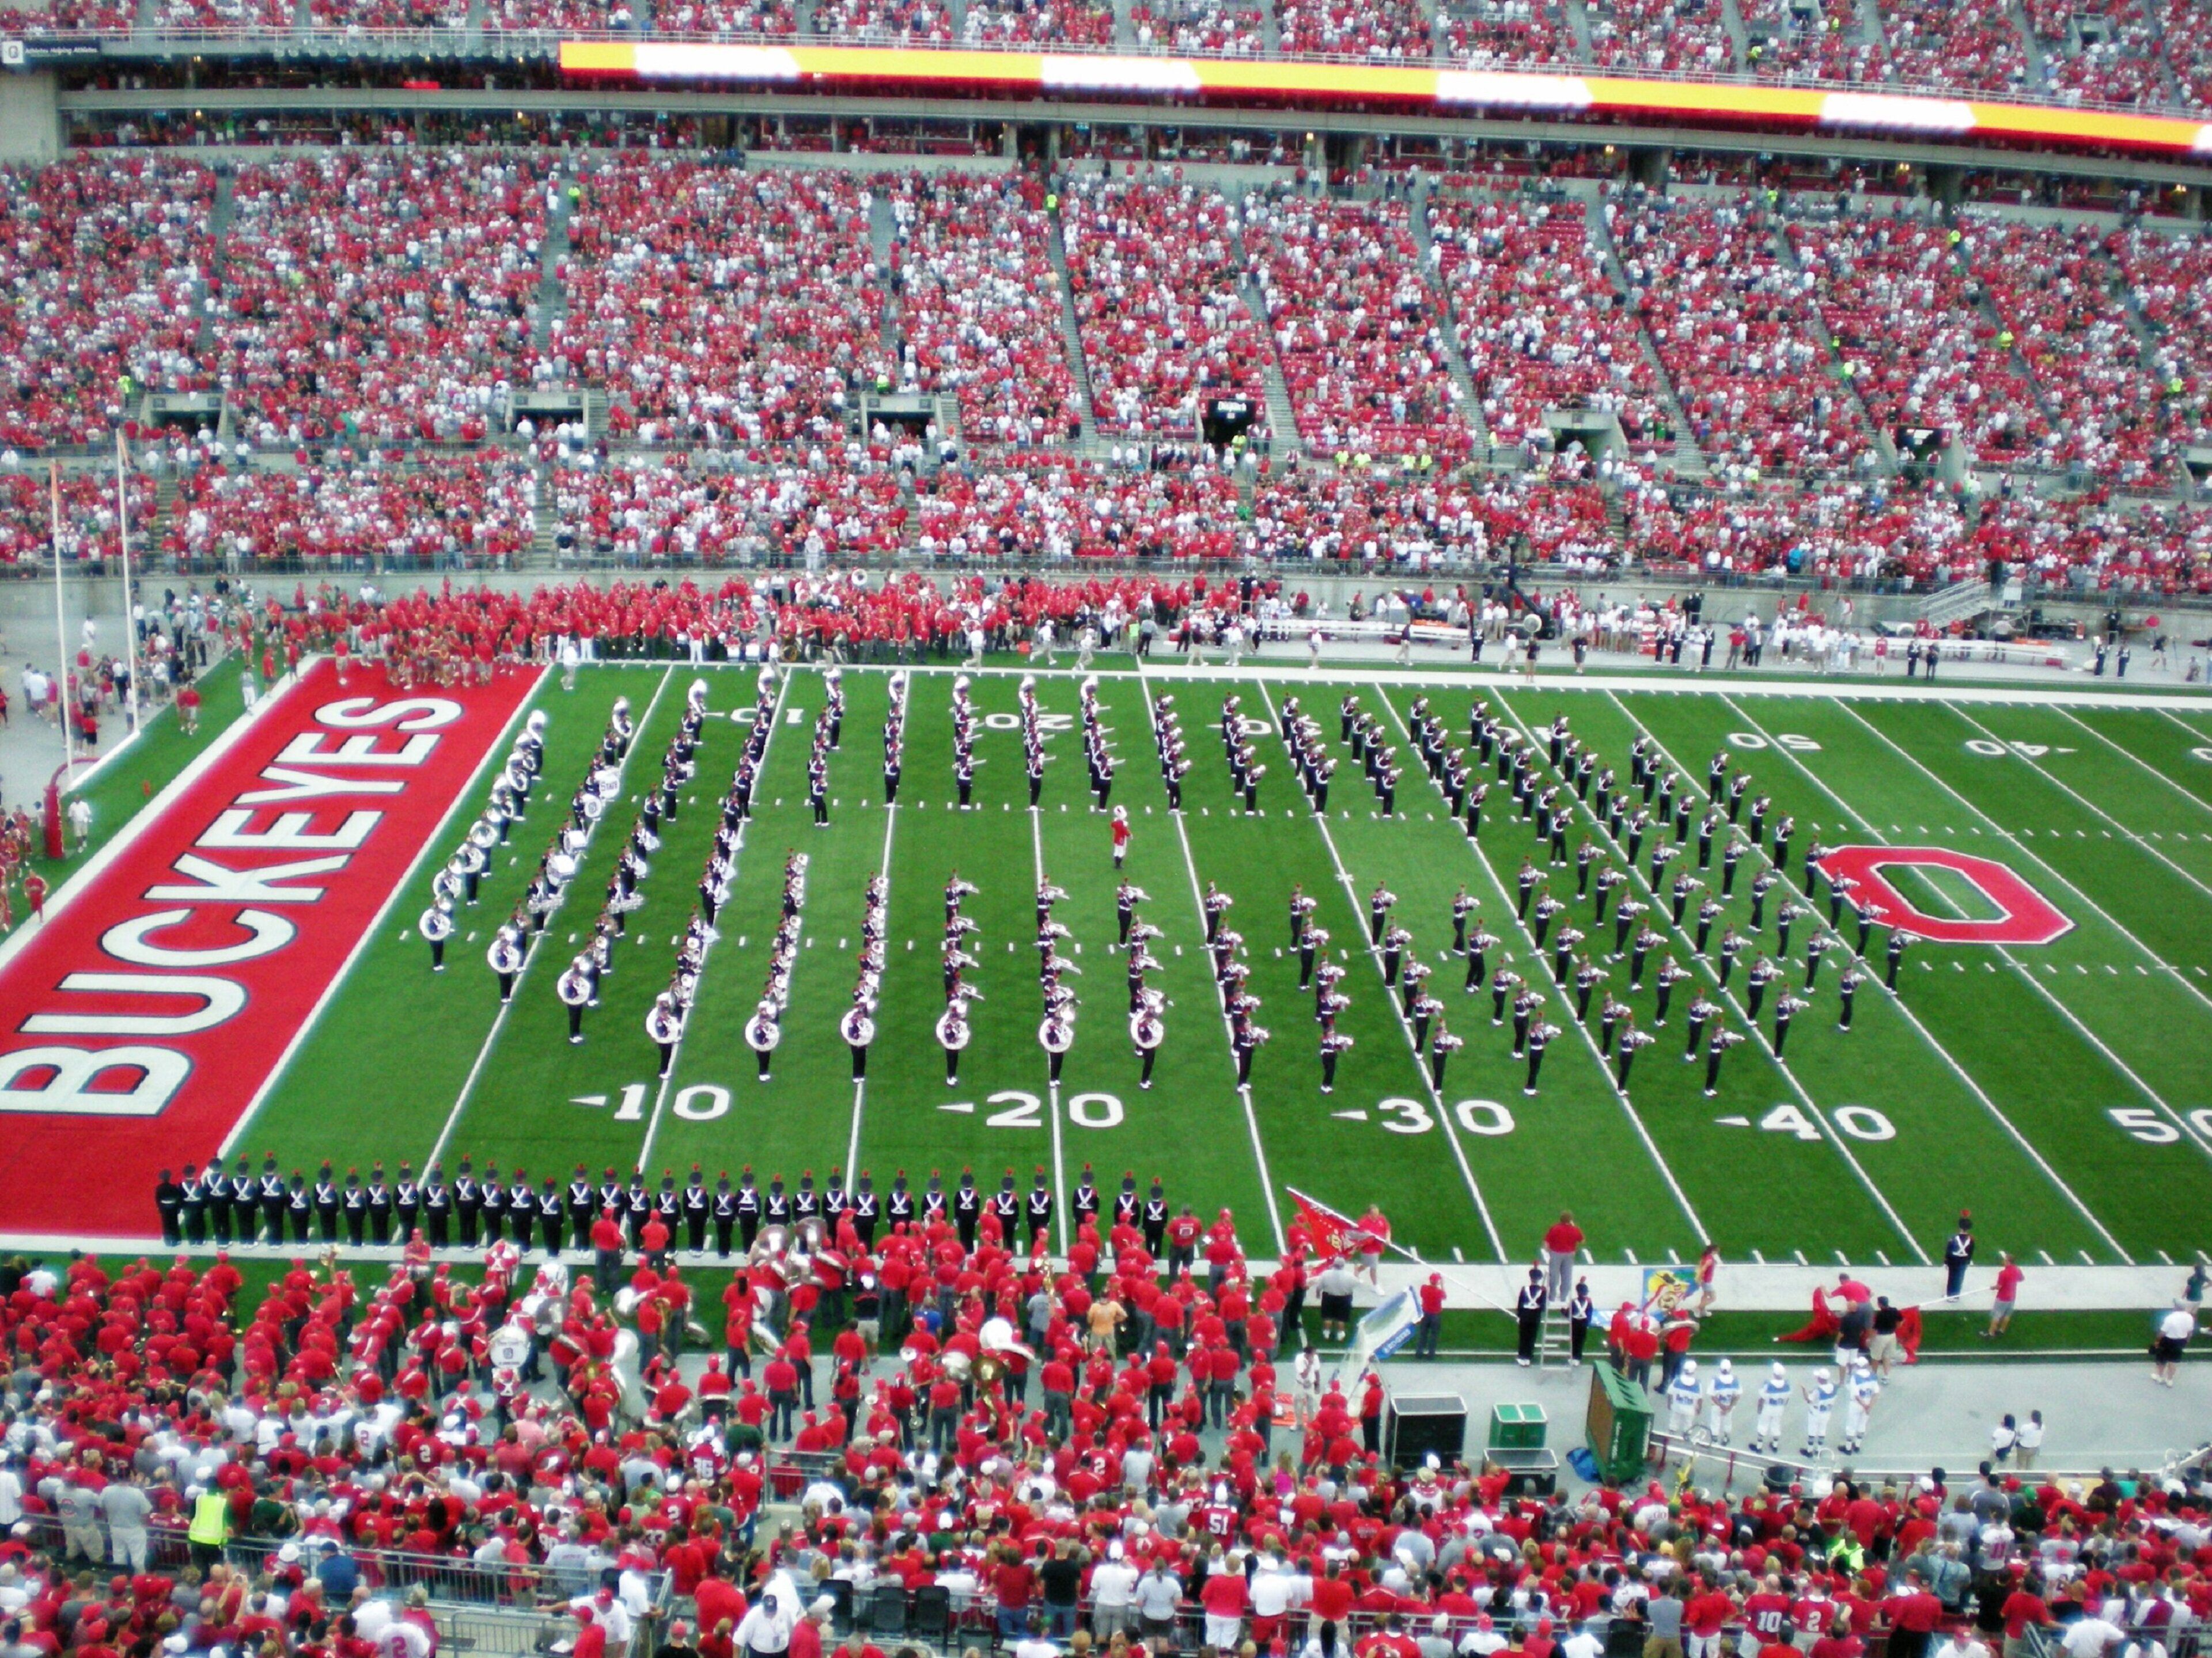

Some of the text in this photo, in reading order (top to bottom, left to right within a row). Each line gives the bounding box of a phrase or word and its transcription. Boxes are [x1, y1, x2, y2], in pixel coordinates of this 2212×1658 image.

[0, 697, 463, 1115] BUCKEYES
[613, 1084, 730, 1120] 10
[986, 1091, 1124, 1128] 20
[1377, 1099, 1515, 1135] 30
[1760, 1105, 1897, 1140] 40
[419, 1444, 431, 1463] 2
[1094, 1456, 1105, 1474] 2
[1209, 1513, 1228, 1535] 51
[1757, 1611, 1783, 1633] 10
[1806, 1611, 1821, 1633] 2
